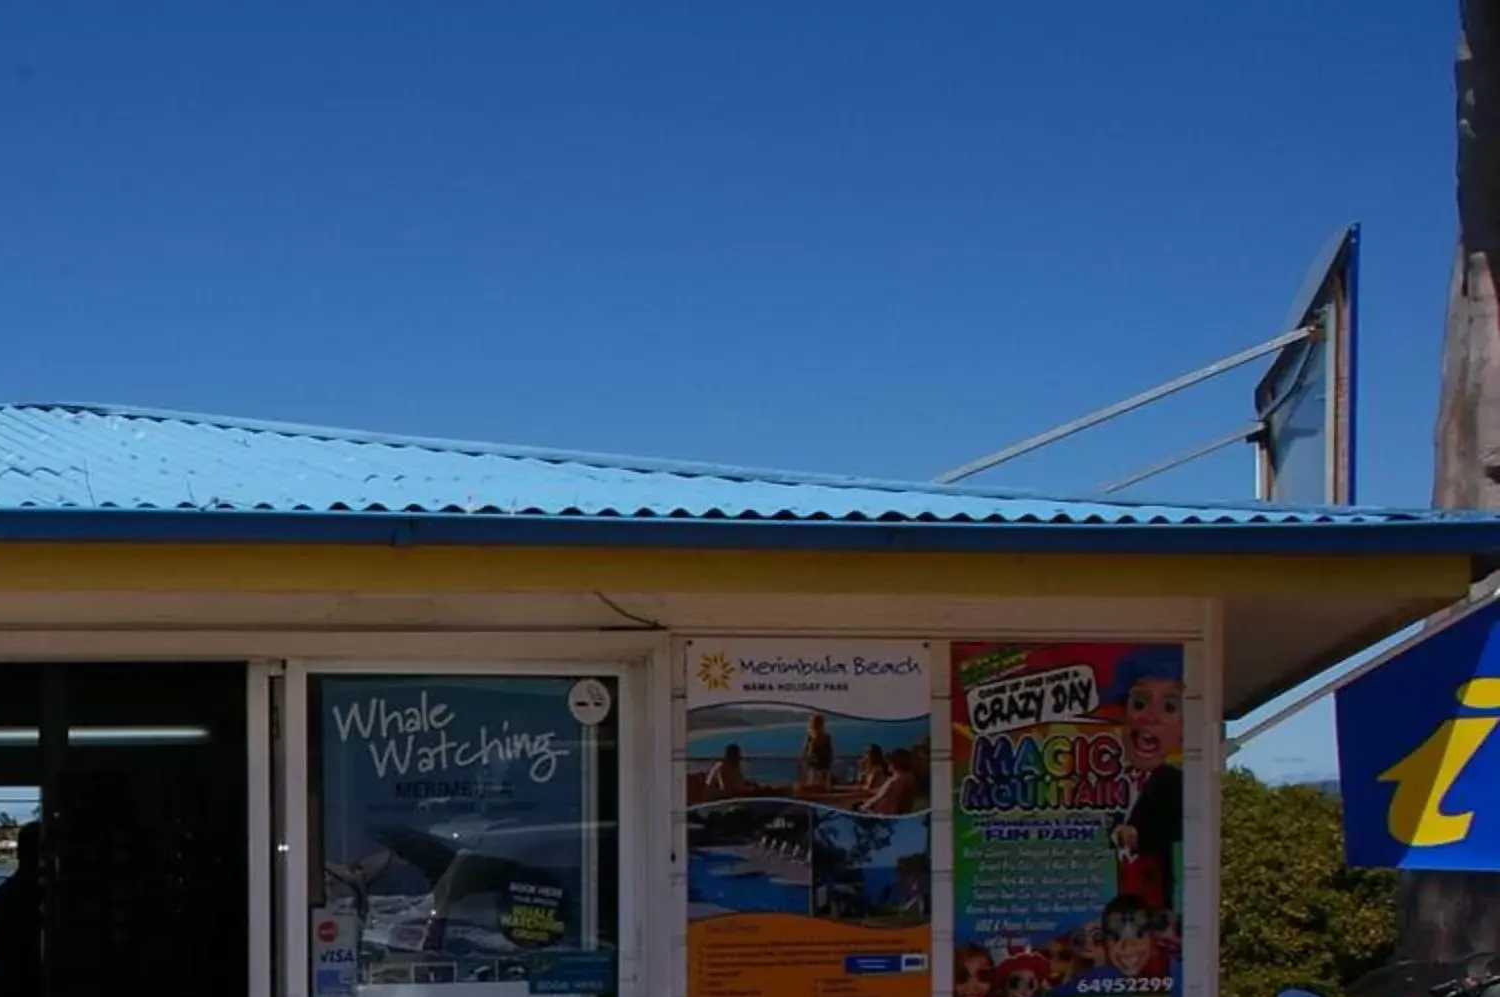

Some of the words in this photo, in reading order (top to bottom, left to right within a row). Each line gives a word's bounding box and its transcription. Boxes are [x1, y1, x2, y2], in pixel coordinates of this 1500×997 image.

[739, 653, 847, 677] Merimbula
[854, 655, 923, 677] Beach
[332, 690, 456, 743] Whale
[973, 688, 1045, 730] CRAZY
[1051, 678, 1093, 714] DAY
[369, 721, 571, 783] Watching
[972, 733, 1124, 777] MAGIC
[960, 775, 1131, 812] MOUNTAIN
[320, 950, 355, 963] VISA
[1076, 976, 1174, 994] 64952299
